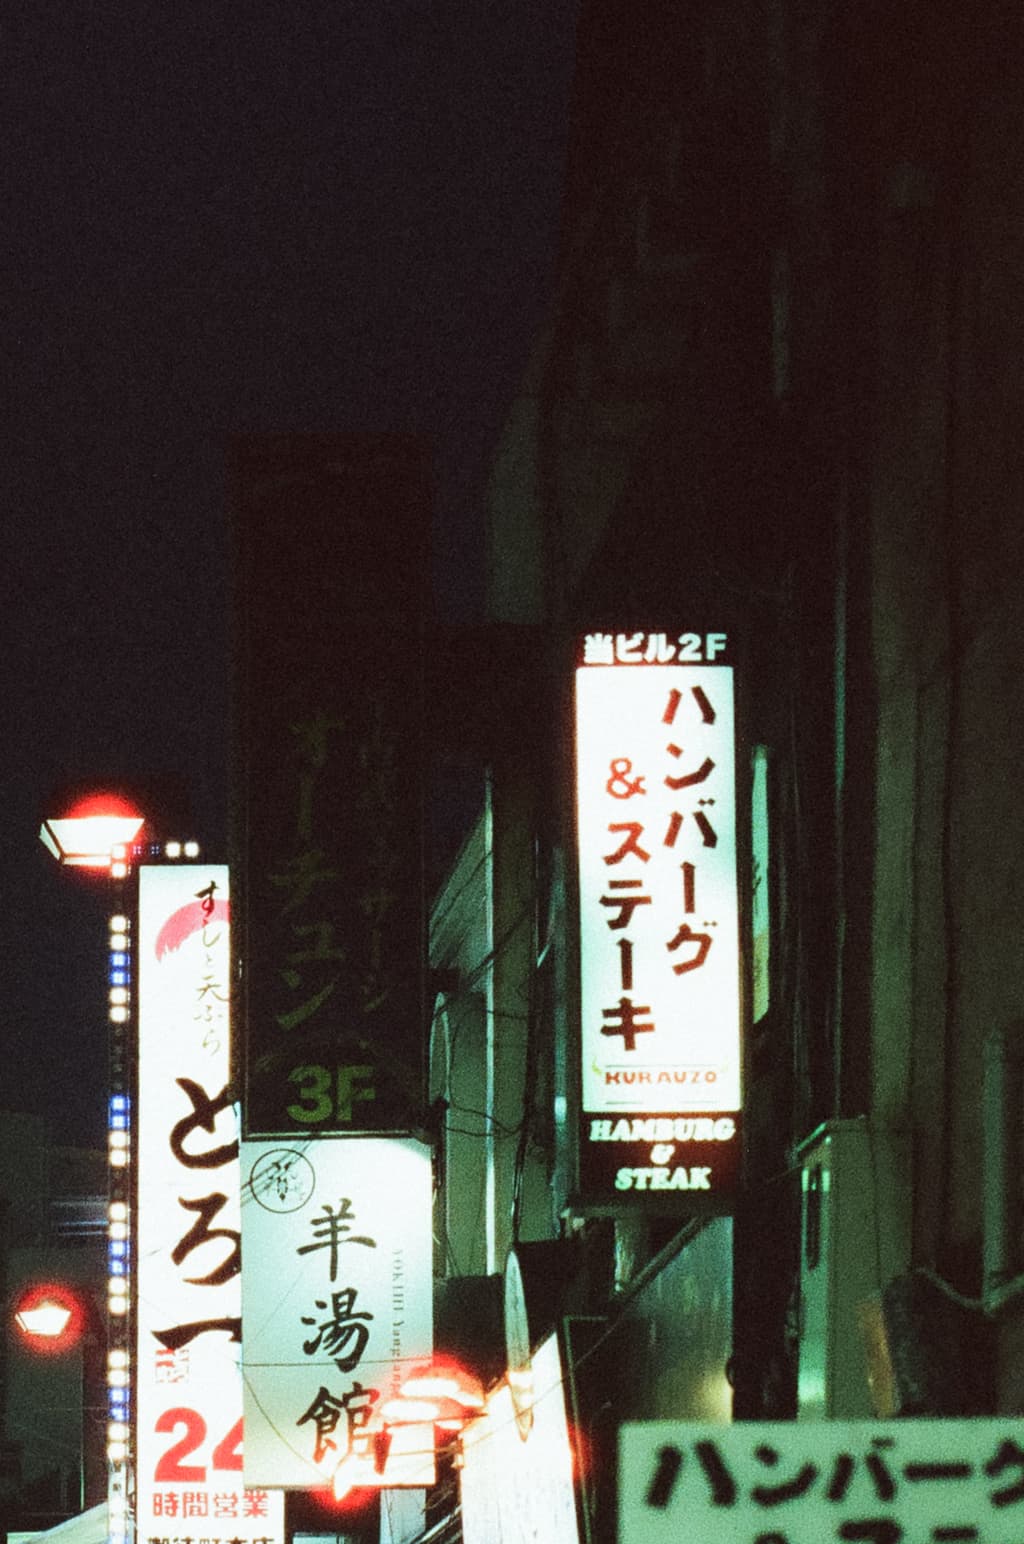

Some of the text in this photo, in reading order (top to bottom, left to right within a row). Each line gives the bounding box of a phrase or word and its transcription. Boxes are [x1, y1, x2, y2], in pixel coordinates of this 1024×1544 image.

[583, 633, 726, 664] 当ビル2F
[662, 685, 718, 975] ハンバーグ
[286, 1063, 376, 1123] 3F
[605, 1071, 718, 1085] KURAUZO
[589, 1118, 735, 1142] HAMBURG
[650, 1145, 674, 1165] &
[614, 1167, 711, 1191] STEAK
[296, 1197, 380, 1472] 羊湯館
[151, 1489, 270, 1519] 時間営業
